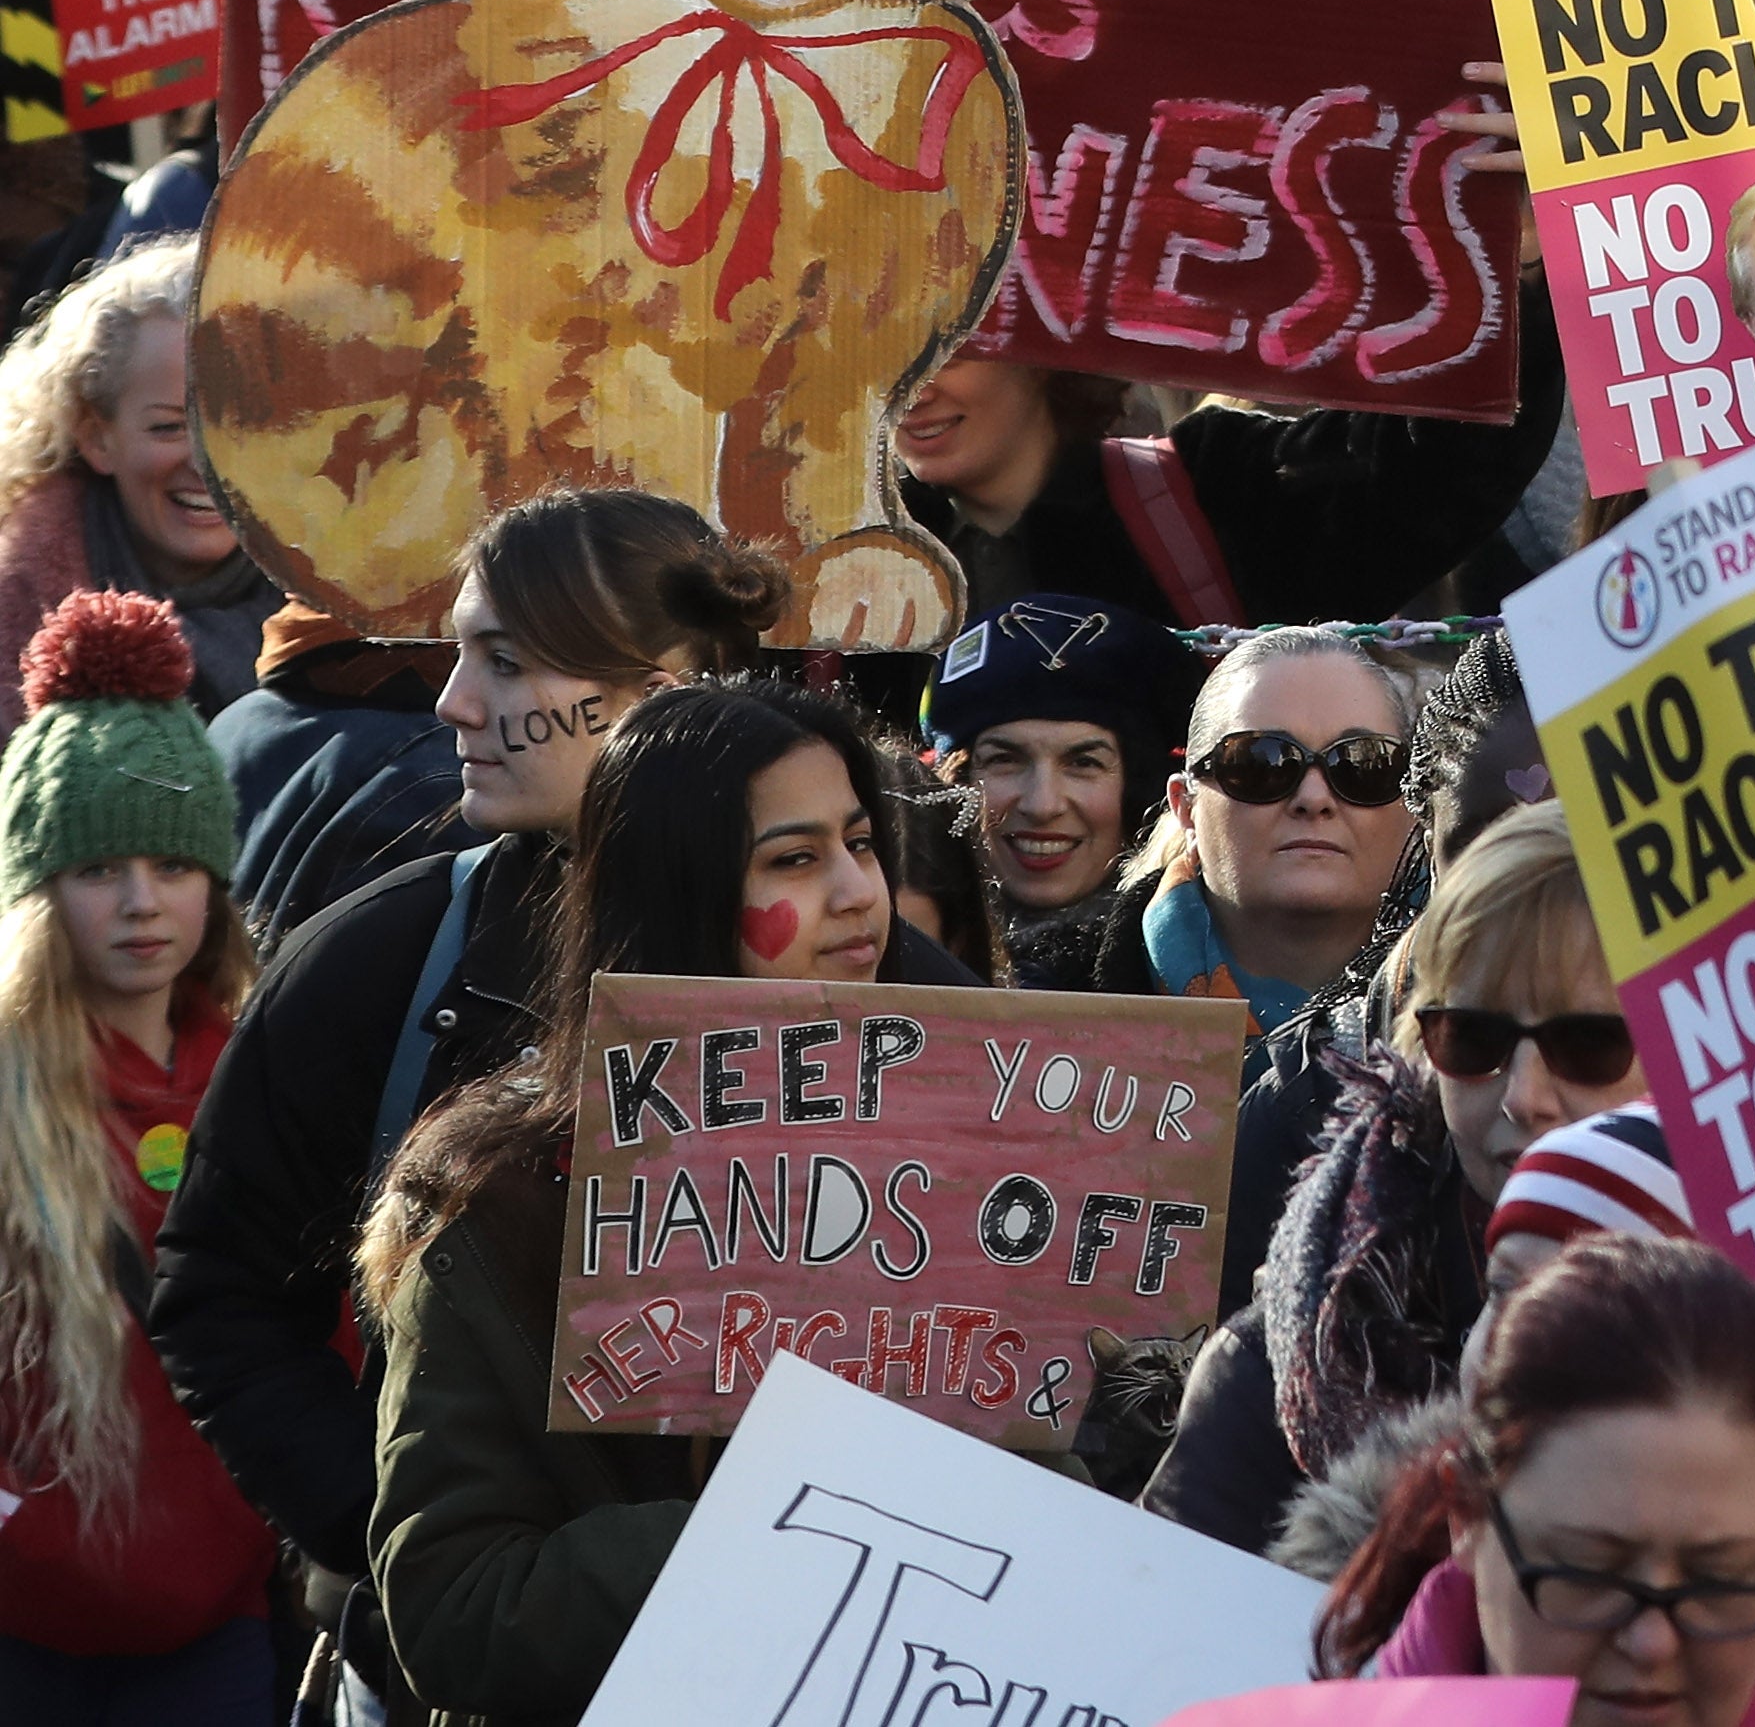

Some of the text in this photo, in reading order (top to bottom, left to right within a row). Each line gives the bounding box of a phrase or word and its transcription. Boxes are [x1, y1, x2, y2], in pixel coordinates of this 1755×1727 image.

[1572, 182, 1713, 289] NO
[1589, 276, 1722, 376] TO
[1665, 562, 1708, 610] TO
[498, 694, 611, 753] LOVE
[1581, 683, 1704, 830] NO
[605, 1014, 1196, 1147] KEEP YOUR
[583, 1152, 1207, 1296] HANDS OFF
[563, 1296, 709, 1422] HER
[1026, 1356, 1072, 1431] &
